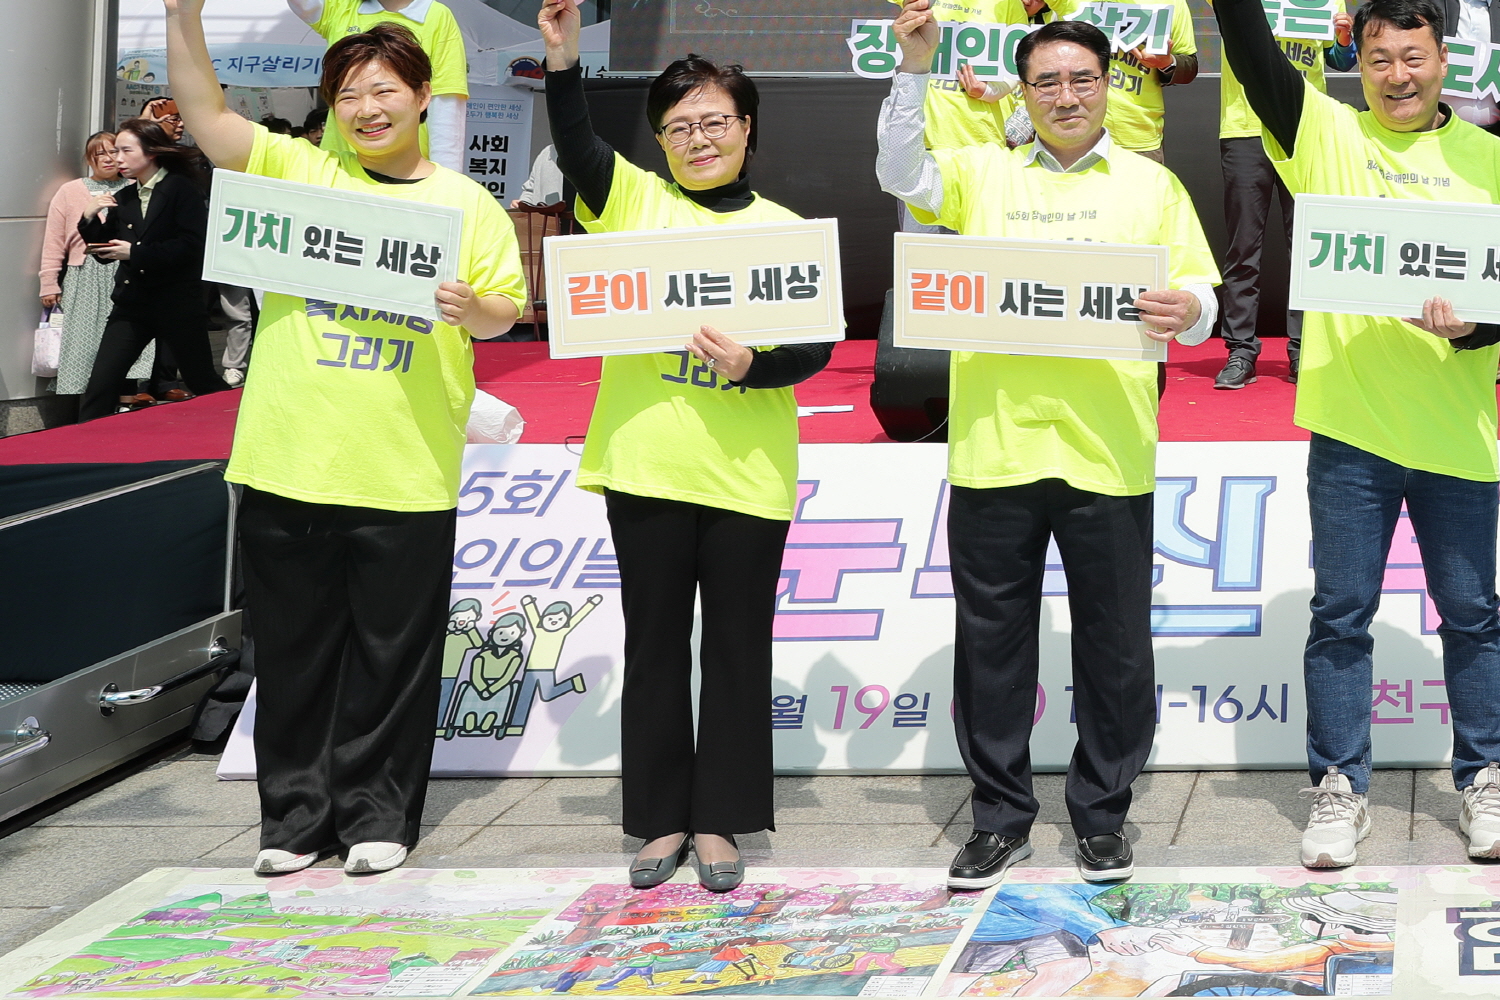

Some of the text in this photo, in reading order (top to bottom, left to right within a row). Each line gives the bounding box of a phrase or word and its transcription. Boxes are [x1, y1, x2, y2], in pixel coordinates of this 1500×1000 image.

[226, 55, 321, 74] 지구살리기
[1109, 67, 1143, 95] 리기
[466, 102, 486, 110] 애인이
[469, 135, 509, 153] 사회
[469, 158, 506, 176] 복지
[1433, 177, 1450, 187] 기념
[1067, 212, 1076, 221] 날
[1079, 209, 1097, 220] 기념
[222, 206, 442, 279] 가치 있는 세상
[1308, 231, 1386, 275] 가치
[1399, 242, 1467, 281] 있는
[568, 264, 821, 317] 같이 사는 세상
[911, 272, 1148, 323] 같이 사는 세상
[316, 332, 415, 373] 그리기
[830, 684, 931, 730] 19일
